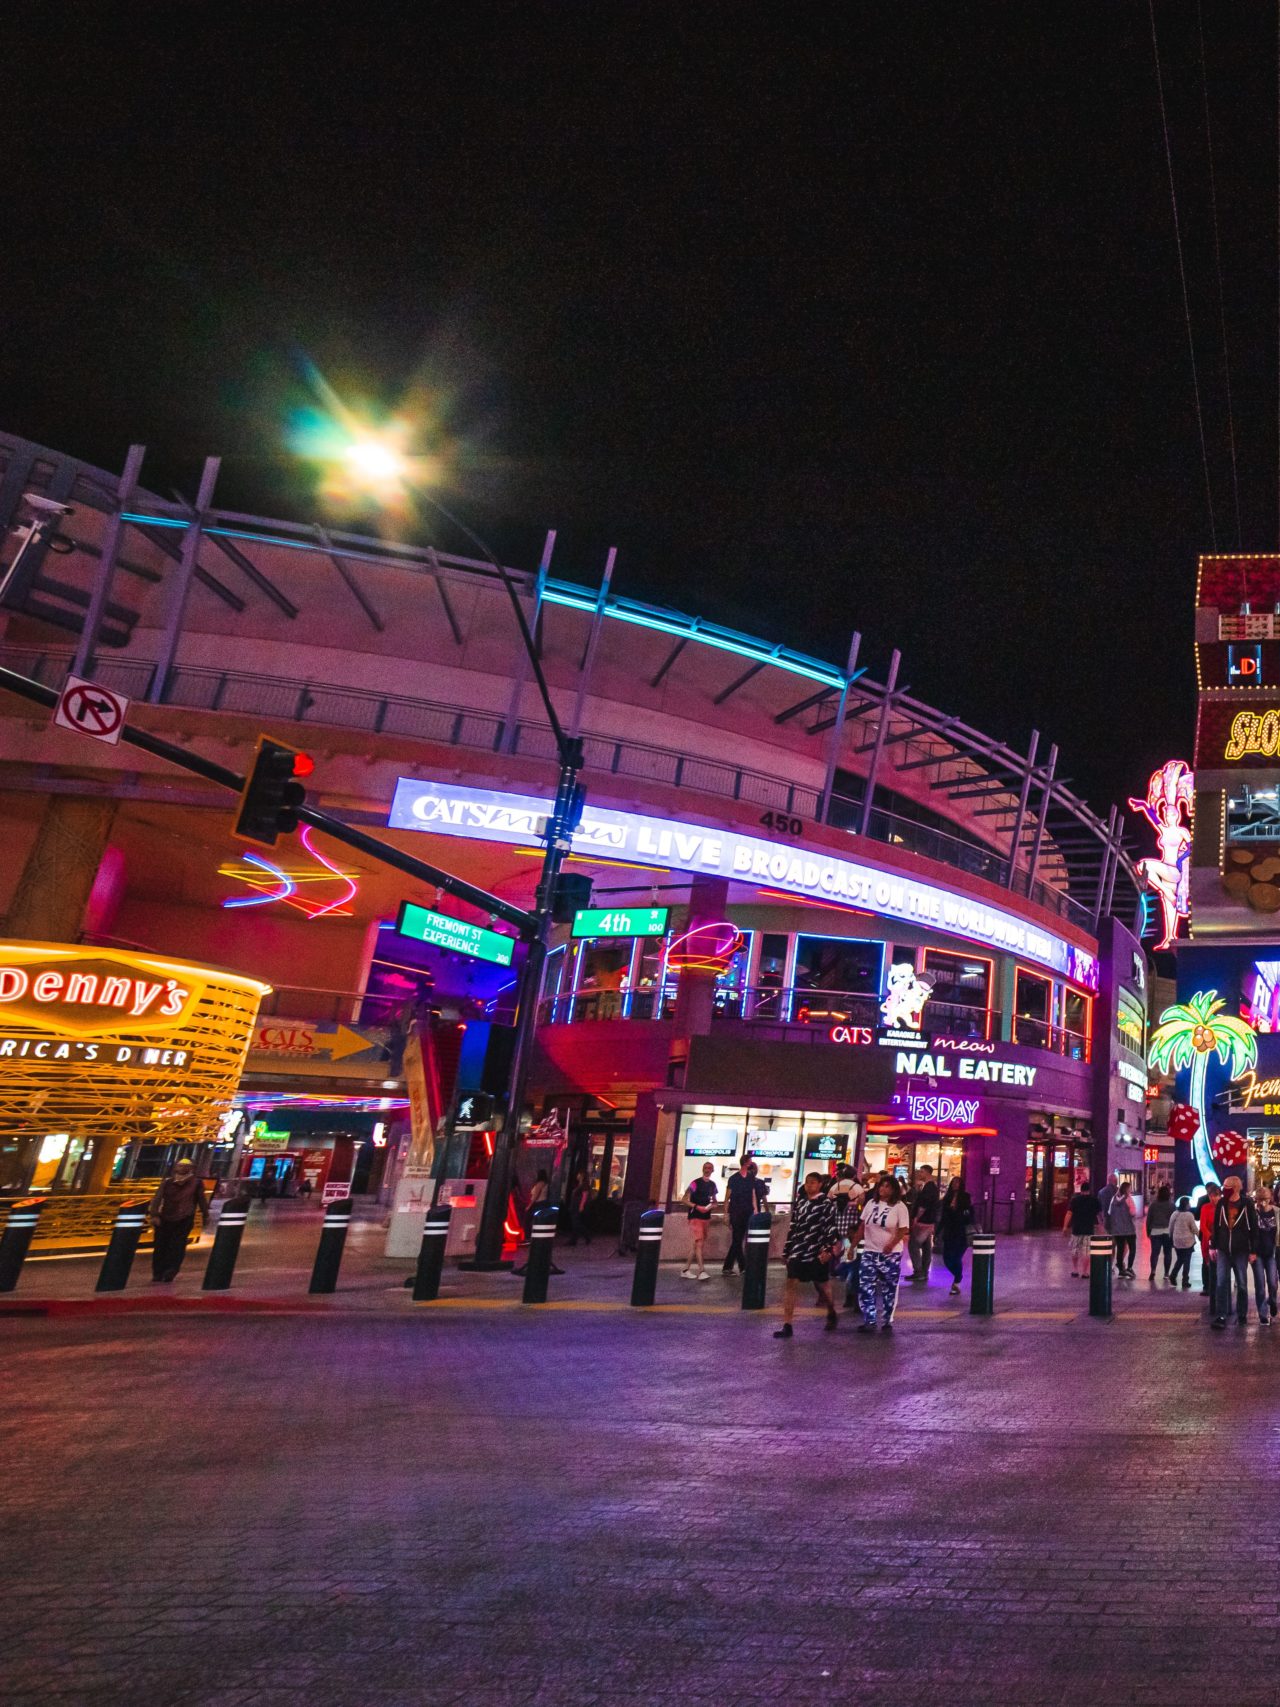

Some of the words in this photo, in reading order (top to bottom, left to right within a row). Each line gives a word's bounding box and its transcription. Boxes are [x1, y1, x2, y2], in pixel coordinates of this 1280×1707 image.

[760, 811, 803, 836] 450
[636, 826, 722, 867] LIVE
[733, 844, 871, 903] BROADCAST
[875, 882, 904, 913] ON
[908, 889, 940, 921] THE
[943, 901, 1025, 950] WORLDWIDE
[426, 913, 471, 937] FREMONT
[471, 928, 483, 941] ST
[598, 913, 631, 932] 4th
[648, 923, 663, 932] 100
[423, 927, 480, 955] EXPERIENCE
[0, 967, 189, 1016] Denny's
[260, 1026, 313, 1047] CATS
[832, 1026, 872, 1045] CATS
[934, 1036, 995, 1053] meow
[879, 1037, 929, 1049] ENTERTAINMENT
[896, 1052, 951, 1077] NAL
[959, 1058, 1037, 1087] EATERY
